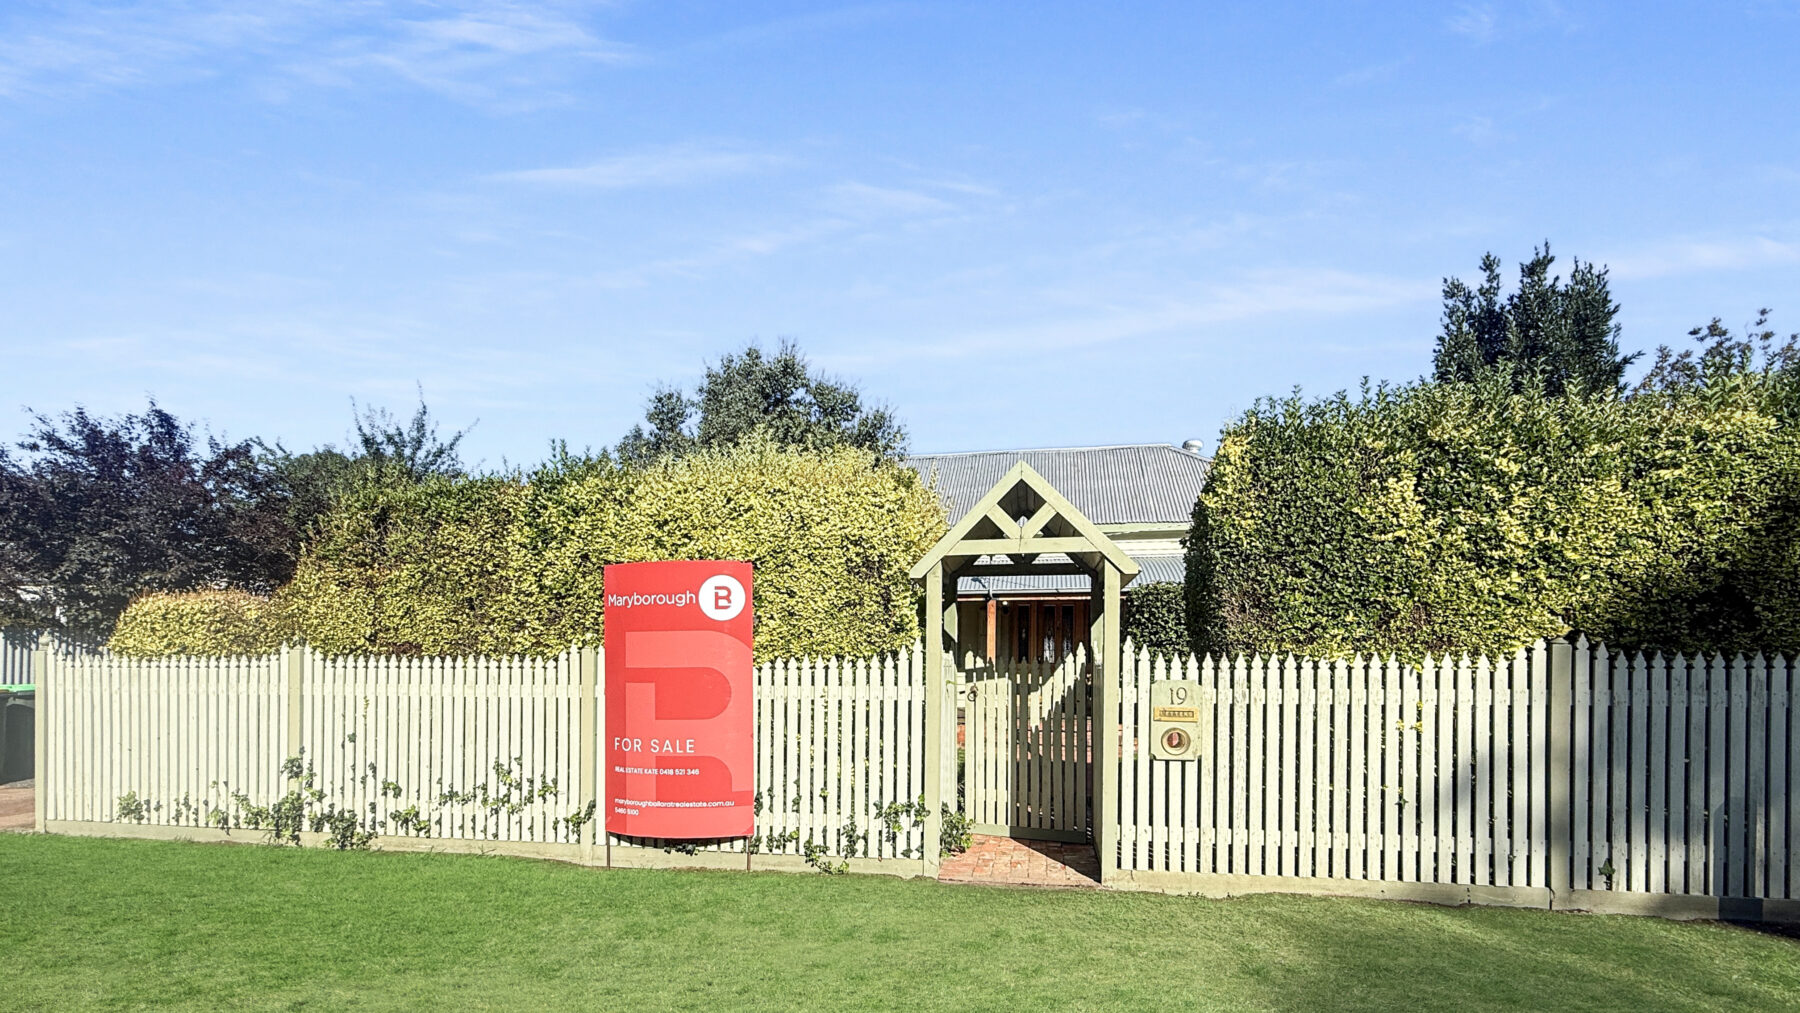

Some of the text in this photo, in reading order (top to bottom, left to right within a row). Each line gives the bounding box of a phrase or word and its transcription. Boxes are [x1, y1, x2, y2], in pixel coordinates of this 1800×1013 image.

[608, 590, 696, 608] Maryborough
[1169, 686, 1188, 705] 19
[614, 737, 695, 753] FOR SALE
[614, 797, 735, 809] maryboroughballaratrealestate.com.au
